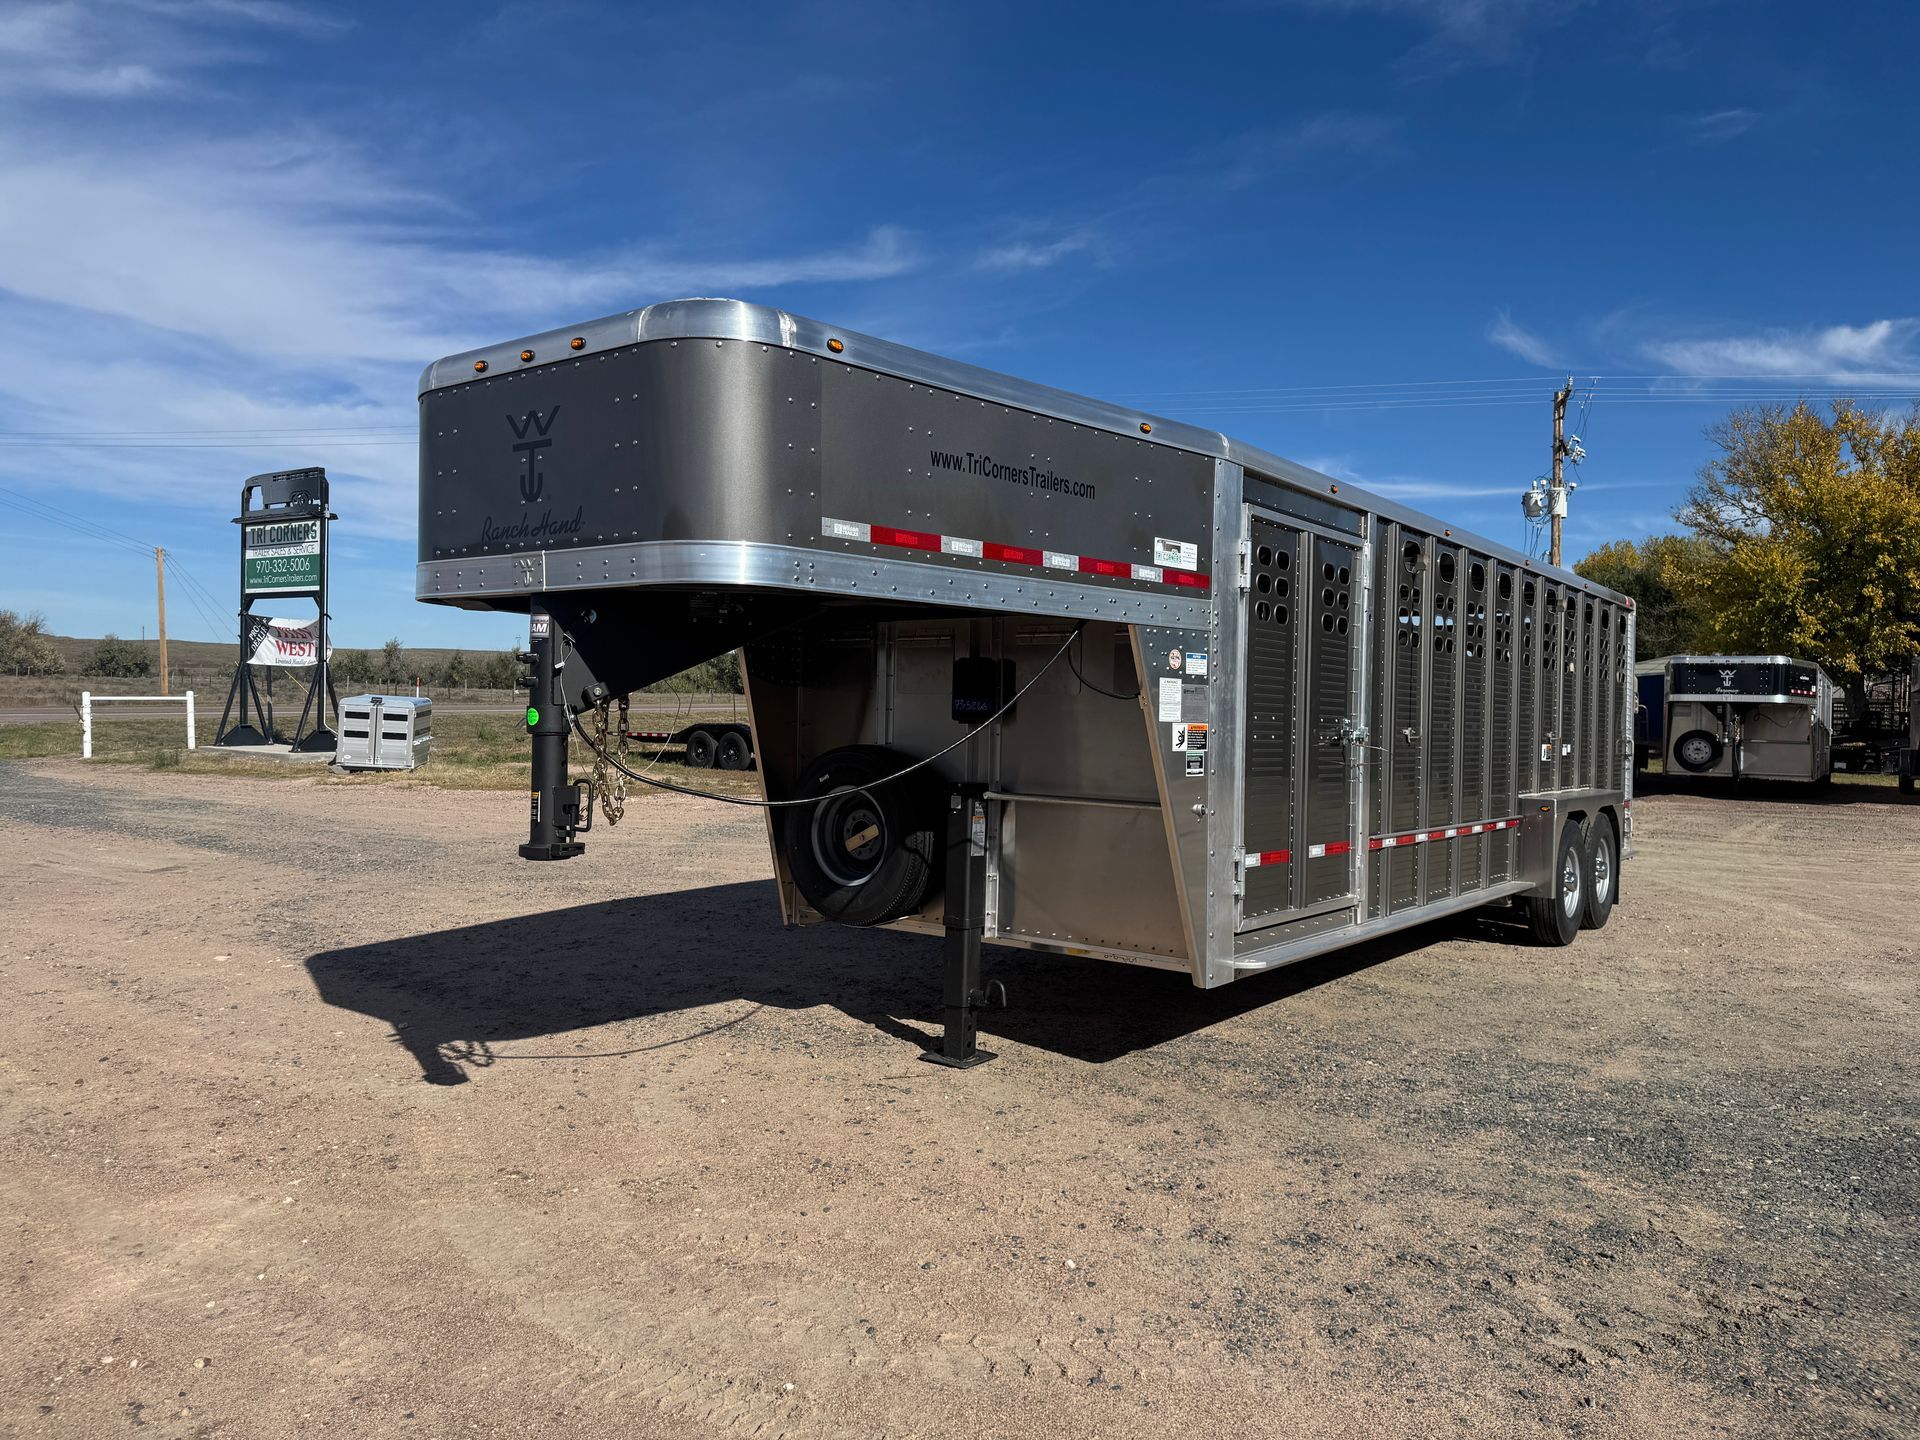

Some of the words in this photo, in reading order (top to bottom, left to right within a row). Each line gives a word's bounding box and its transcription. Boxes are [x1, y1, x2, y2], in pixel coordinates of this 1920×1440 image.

[930, 450, 1096, 499] www.TriCornersTrailers.com
[250, 527, 266, 545] TRI
[269, 522, 317, 543] CORNERS
[481, 512, 529, 542] Ranch
[531, 505, 583, 537] Hand
[270, 546, 287, 556] SALES
[293, 543, 315, 555] SERVICE
[255, 557, 311, 574] 970-332-5006
[275, 640, 313, 657] WEST
